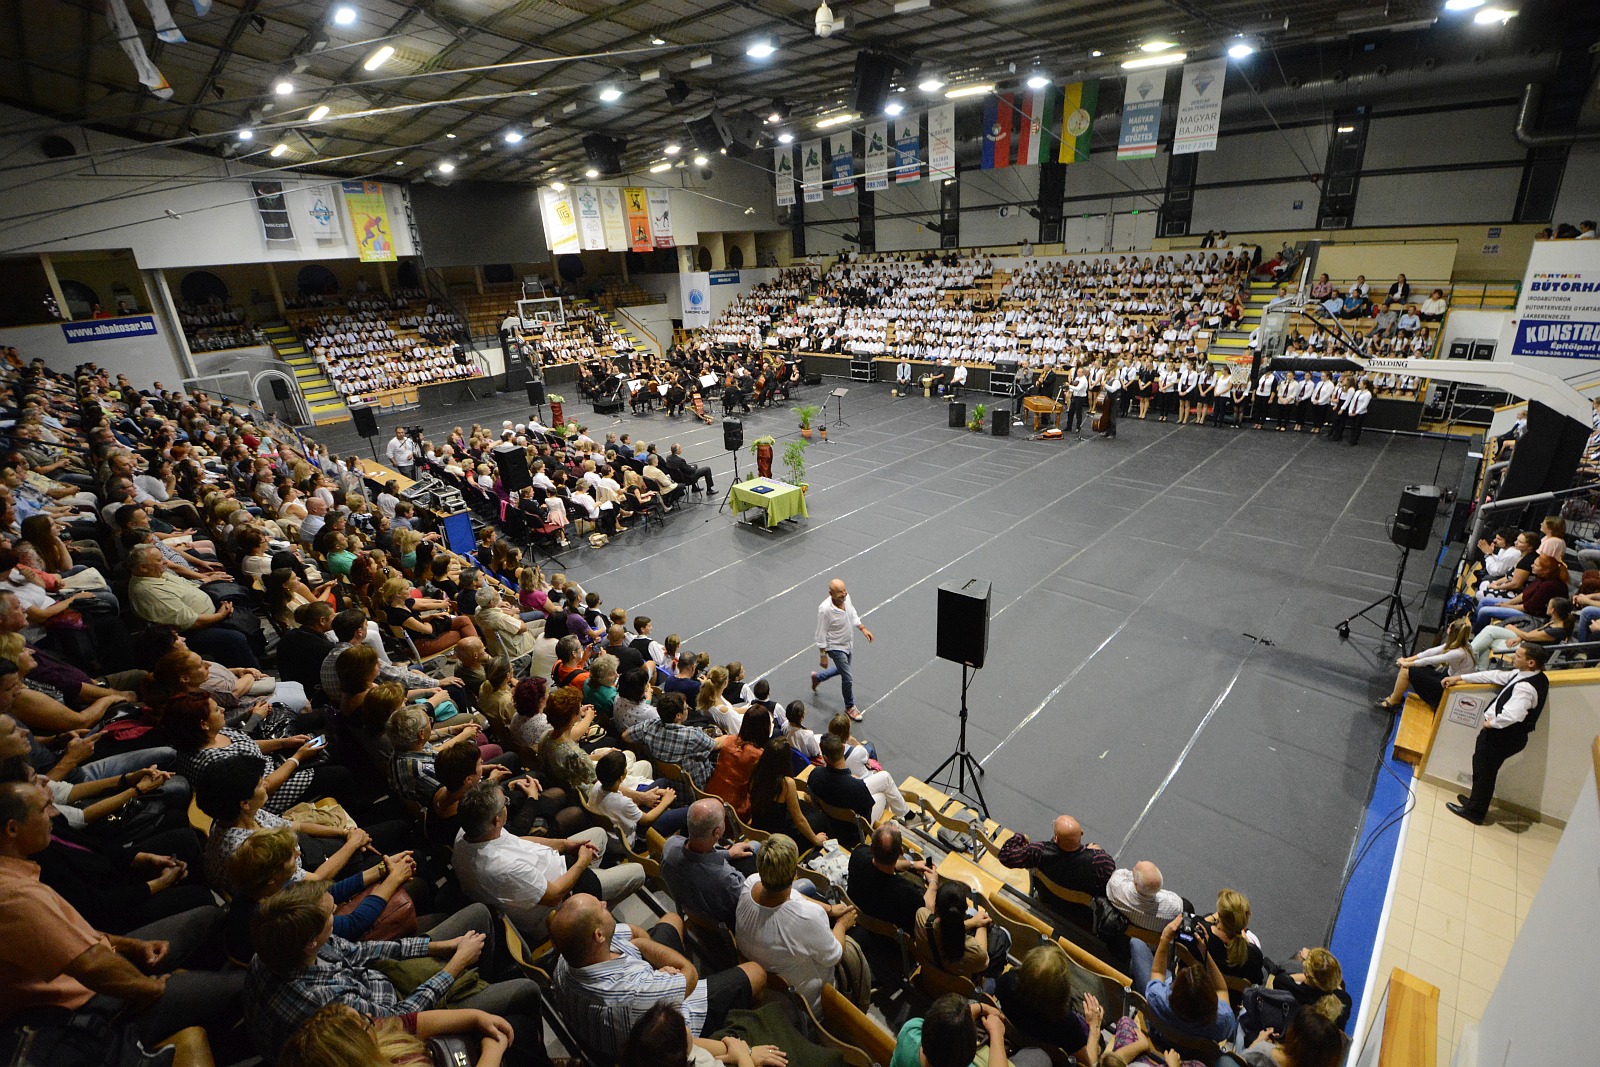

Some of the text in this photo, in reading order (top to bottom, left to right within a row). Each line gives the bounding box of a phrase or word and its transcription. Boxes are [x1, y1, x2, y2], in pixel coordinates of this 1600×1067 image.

[1128, 115, 1154, 124] MAGYAR
[1180, 112, 1217, 124] MAGYAR
[1132, 124, 1148, 132] KUPA
[1178, 124, 1215, 135] BAJNOK
[66, 321, 153, 338] www.albakosar.hu
